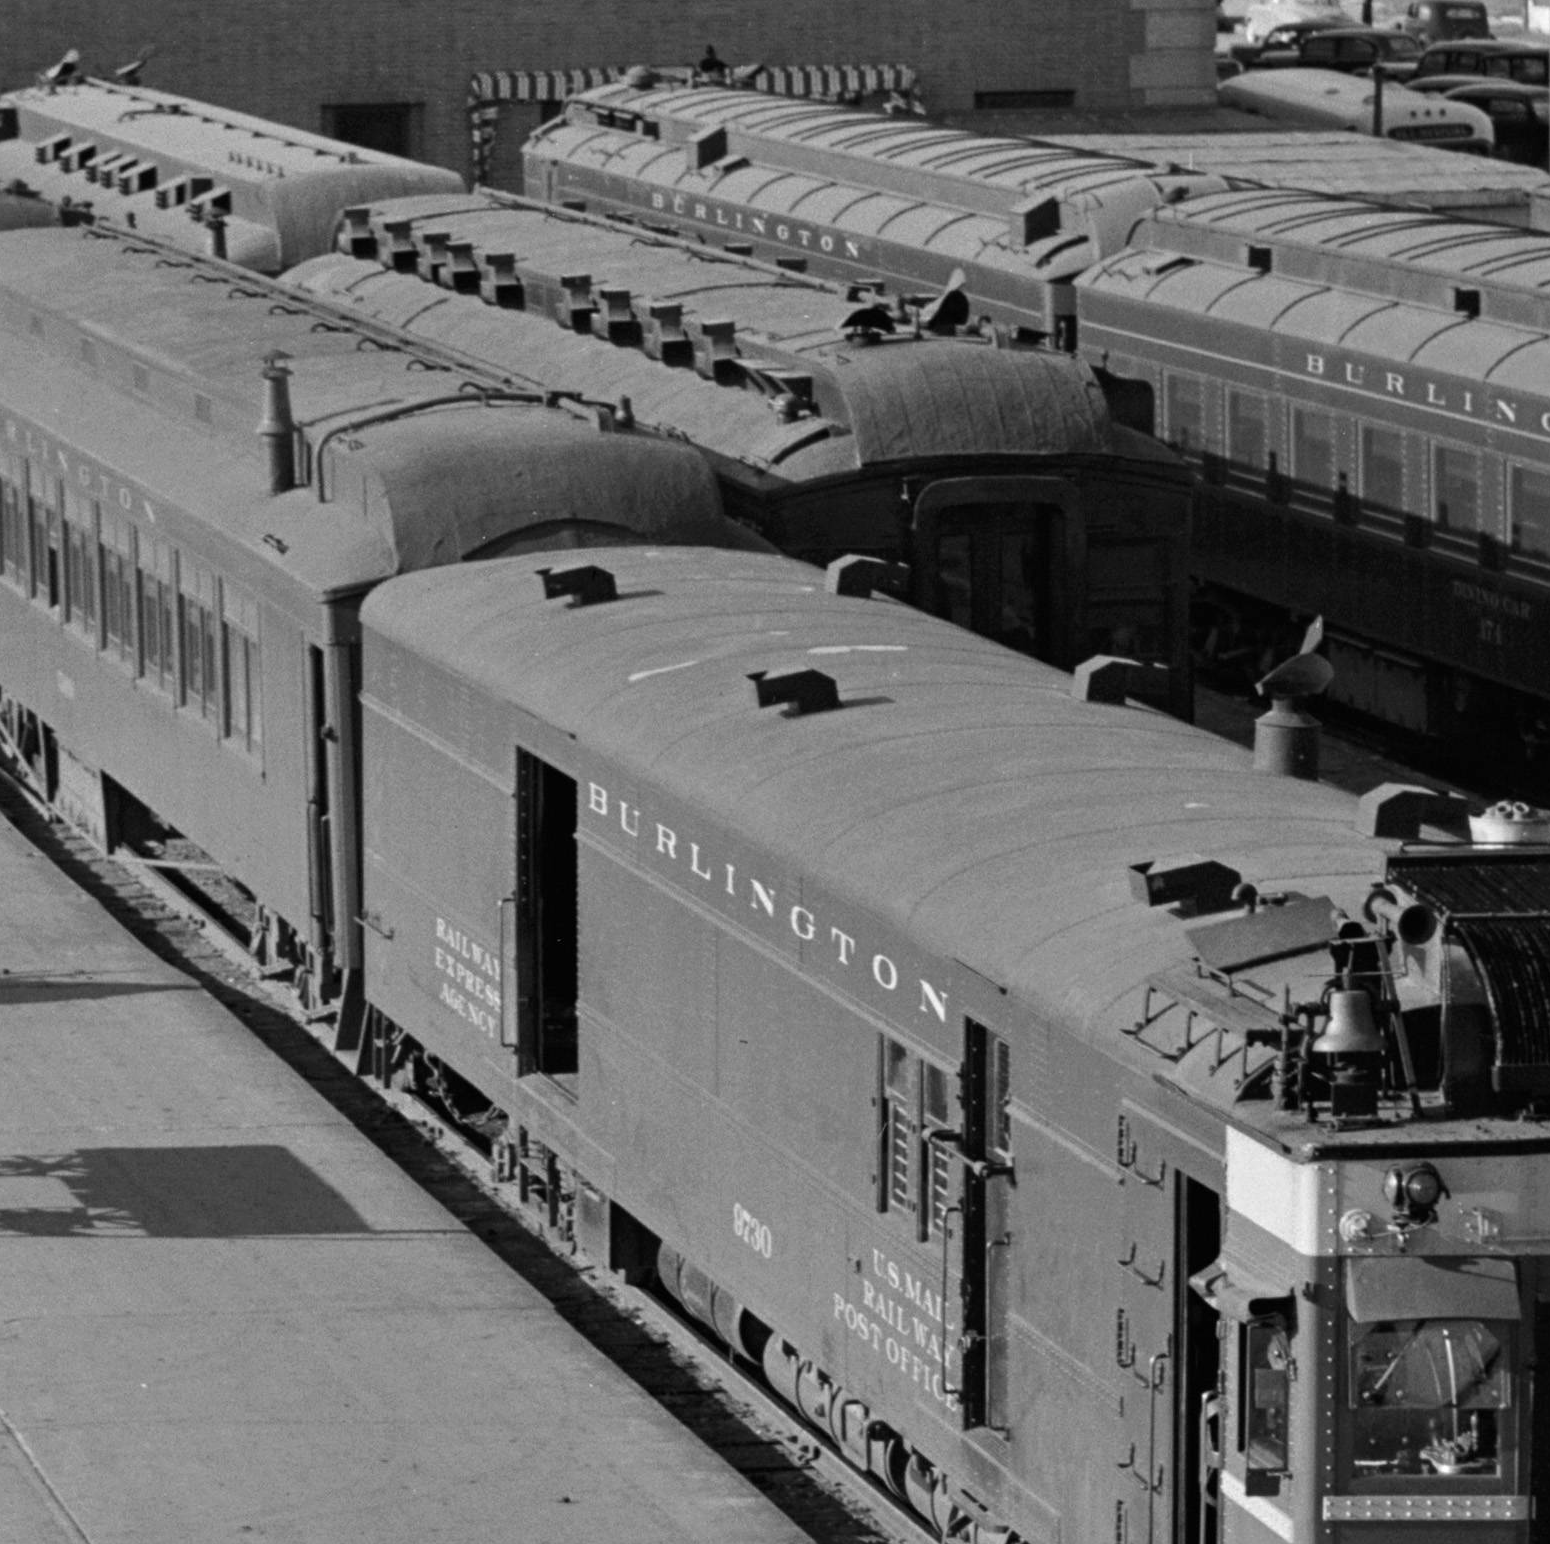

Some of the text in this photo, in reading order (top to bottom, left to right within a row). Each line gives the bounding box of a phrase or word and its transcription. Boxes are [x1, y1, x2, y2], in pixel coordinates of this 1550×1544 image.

[650, 192, 860, 259] BURLINGTON
[589, 782, 949, 1023] BURLINGTON
[435, 947, 502, 1013] EXPRESS
[439, 983, 496, 1039] AGENCY
[733, 1202, 772, 1259] 9730
[833, 1292, 958, 1412] POST OFFICE
[863, 1279, 955, 1370] RAILWAY
